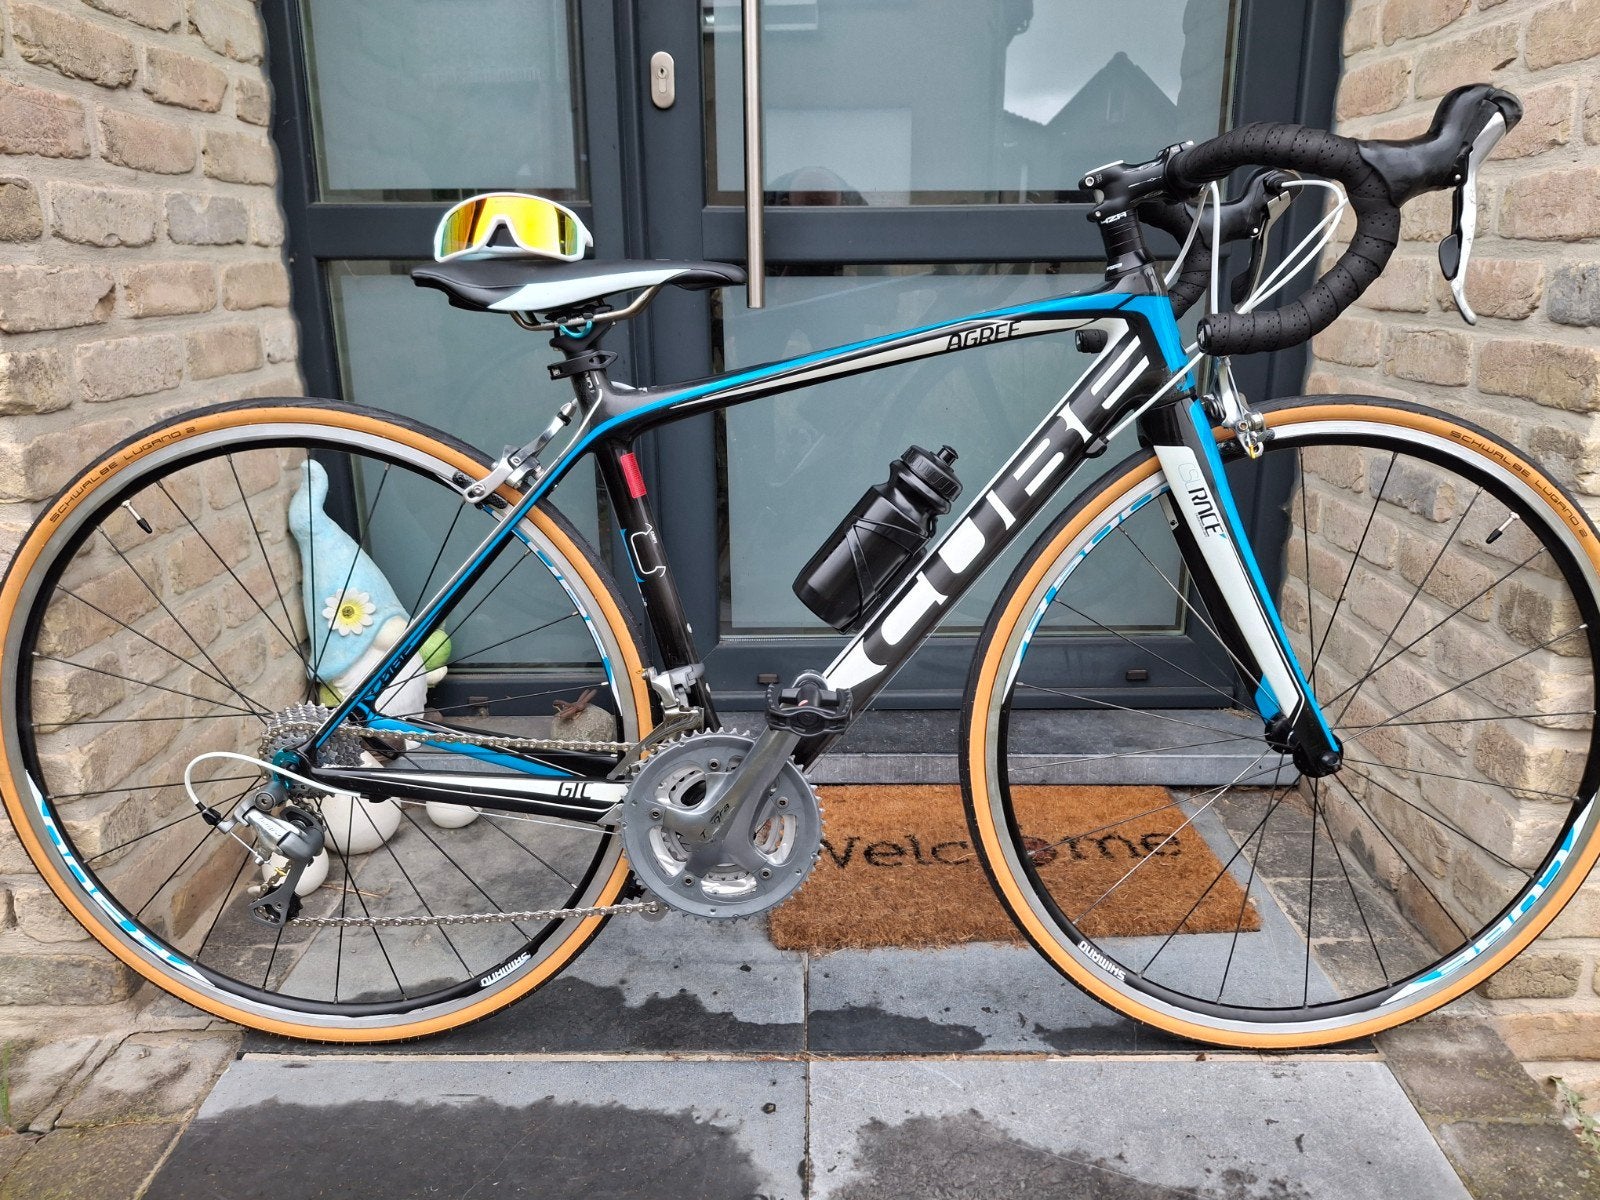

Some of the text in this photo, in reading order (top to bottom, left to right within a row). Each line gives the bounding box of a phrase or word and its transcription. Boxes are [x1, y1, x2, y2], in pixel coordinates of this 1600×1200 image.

[946, 320, 1022, 351] AGREE
[50, 461, 118, 522] SCHWALBE
[124, 431, 182, 460] LUGANO
[1450, 430, 1588, 538] SCHWALBE LUGANO 2
[1188, 487, 1224, 537] RACE
[1078, 940, 1127, 981] SHIMANO
